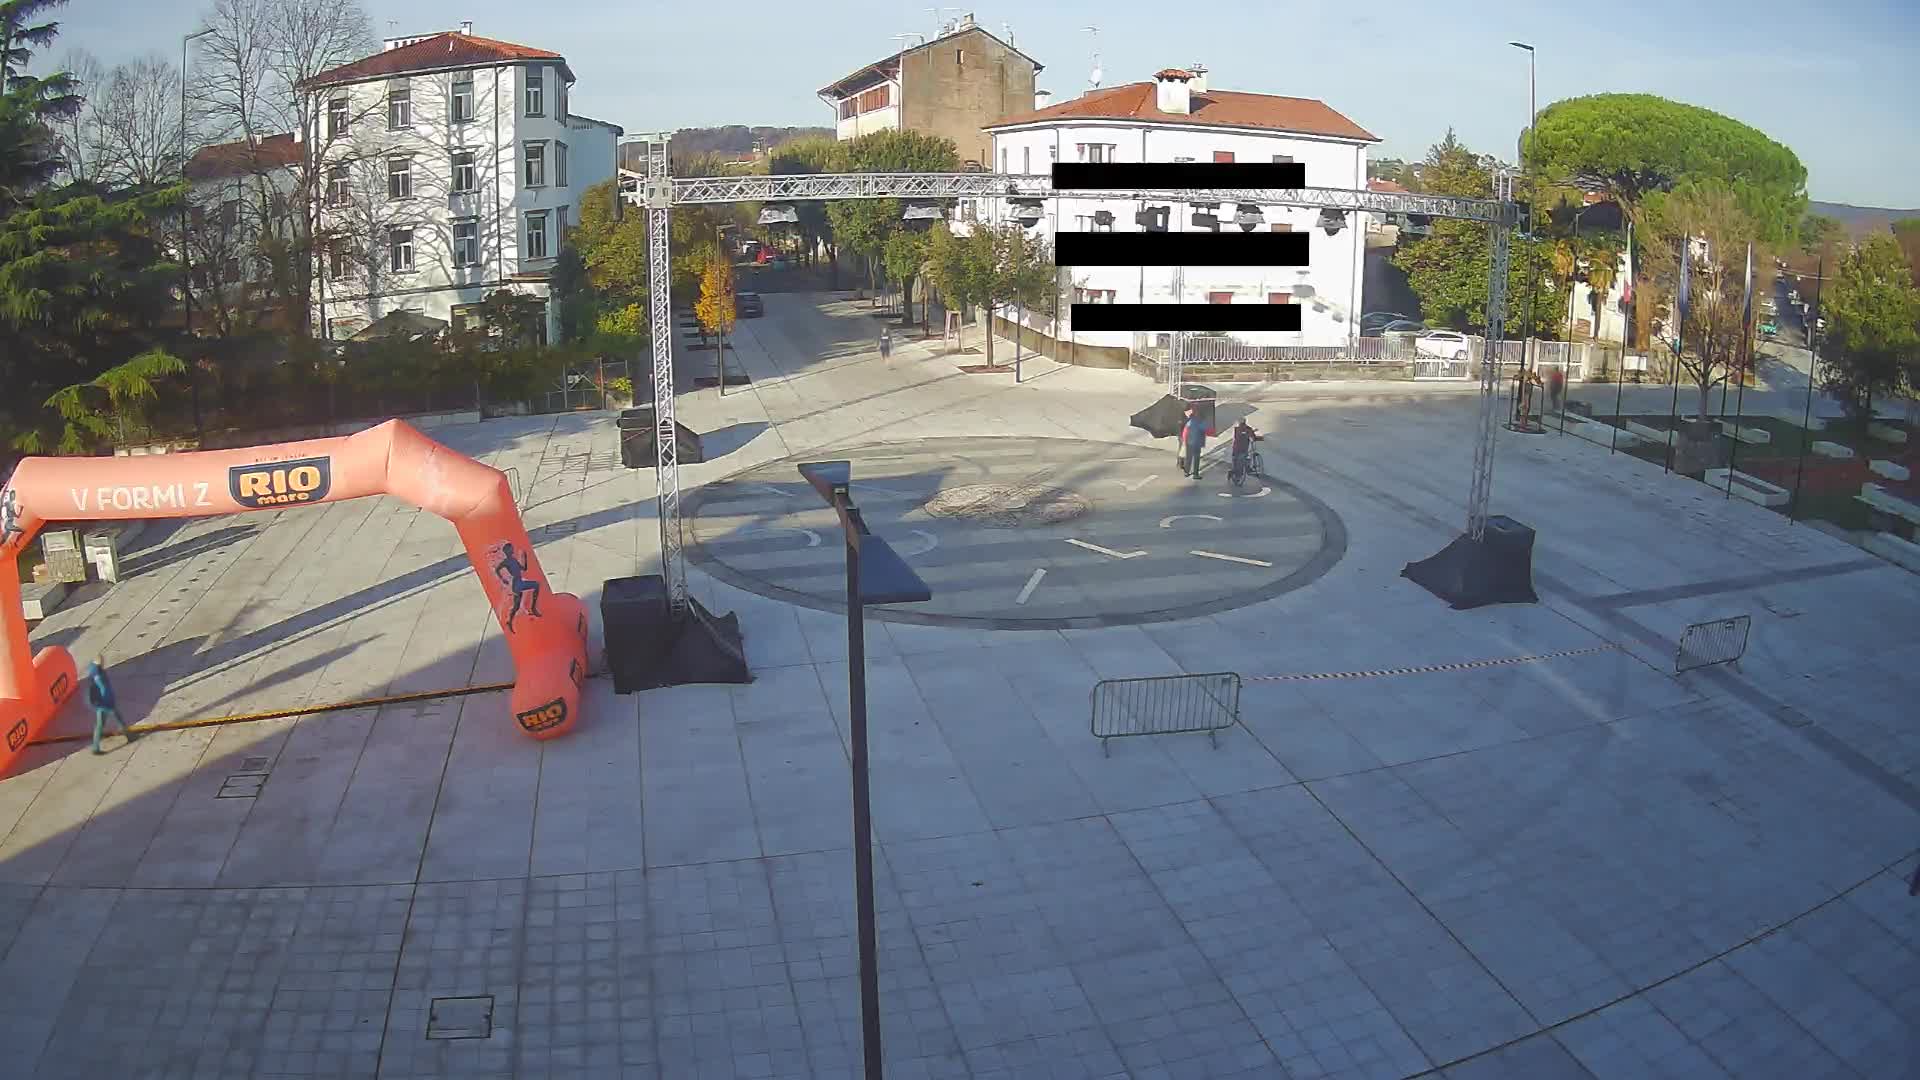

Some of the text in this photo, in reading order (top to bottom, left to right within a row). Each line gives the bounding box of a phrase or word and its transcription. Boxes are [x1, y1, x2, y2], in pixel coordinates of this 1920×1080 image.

[240, 466, 321, 497] RIO
[70, 482, 213, 511] V FORMI Z
[257, 492, 310, 505] mare
